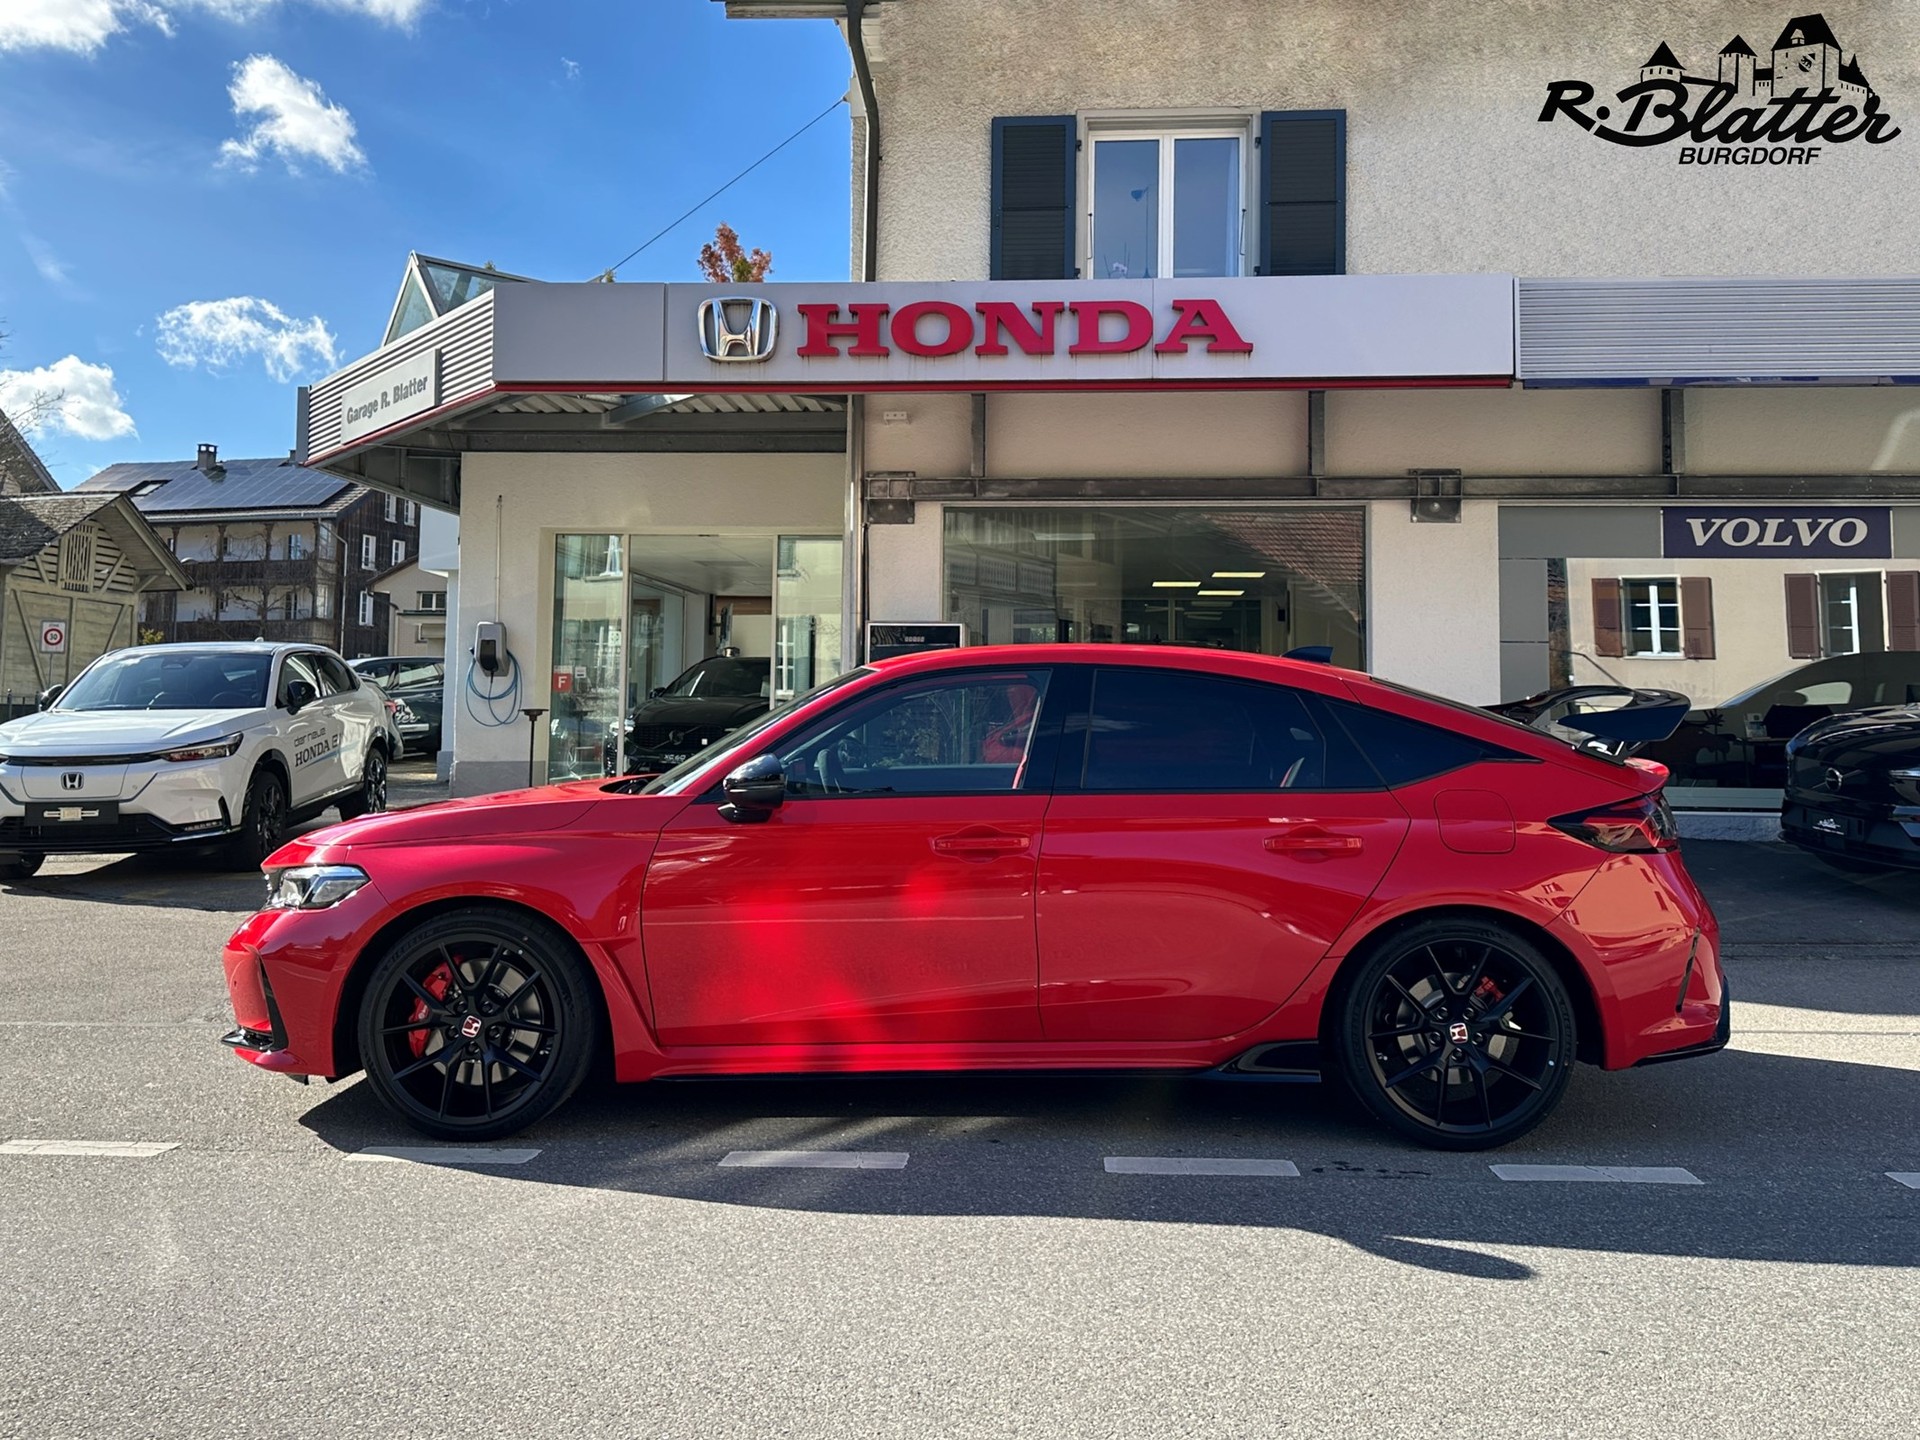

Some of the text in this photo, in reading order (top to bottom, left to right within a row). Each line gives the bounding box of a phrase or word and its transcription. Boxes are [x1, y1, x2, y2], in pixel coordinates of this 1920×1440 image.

[797, 299, 1254, 357] HONDA
[346, 376, 428, 425] Garage R. Blatter
[1685, 517, 1868, 547] VOLVO
[558, 676, 567, 688] F
[295, 739, 330, 767] HONDA
